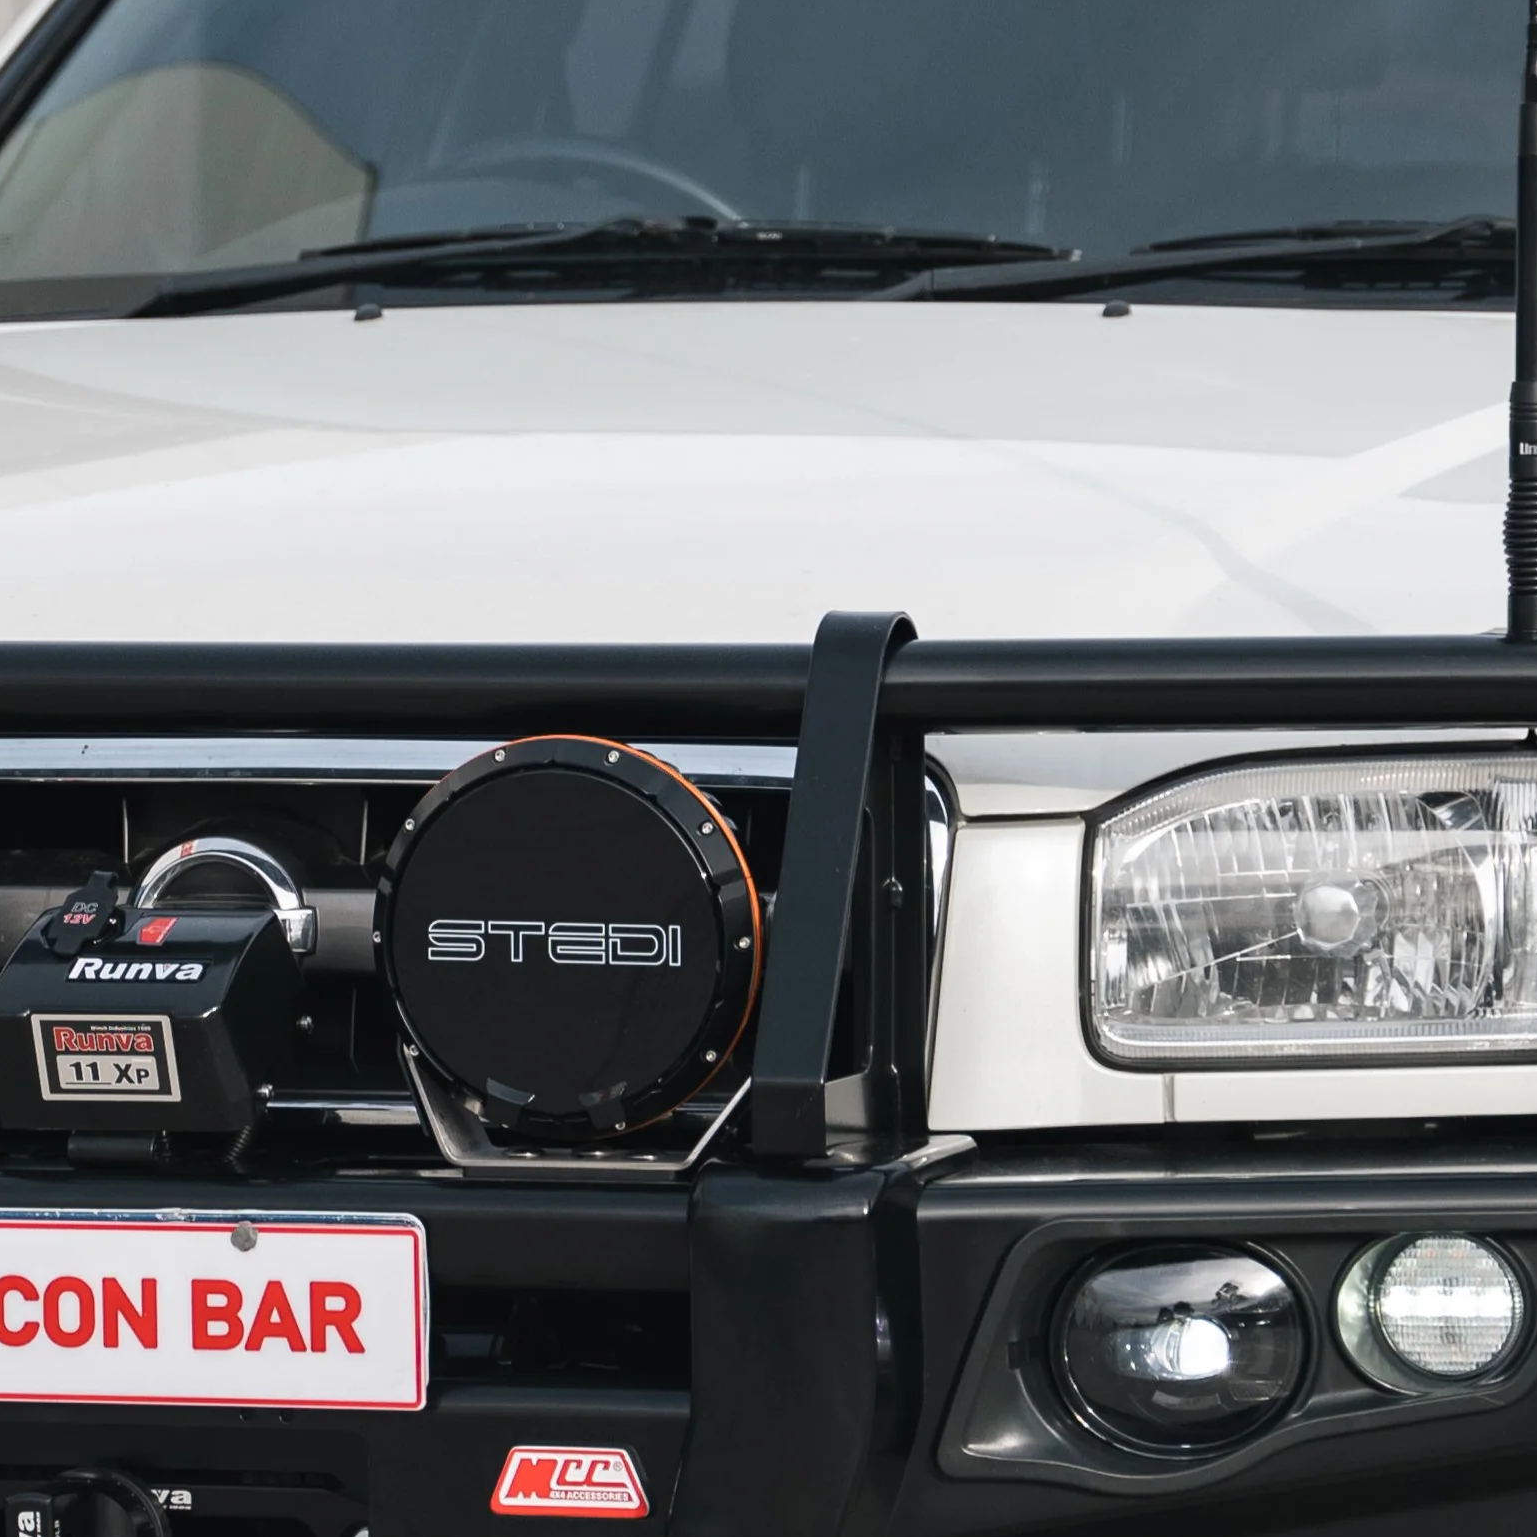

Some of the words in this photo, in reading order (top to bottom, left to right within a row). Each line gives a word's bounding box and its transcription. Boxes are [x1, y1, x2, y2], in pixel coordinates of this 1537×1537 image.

[71, 901, 98, 913] DC
[63, 913, 96, 925] 12V
[428, 919, 681, 966] STEDI
[68, 957, 203, 981] Runva
[53, 1026, 154, 1052] Runva
[69, 1061, 100, 1081] 11
[190, 1279, 365, 1354] BAR
[567, 1491, 628, 1502] ACCESSORIES
